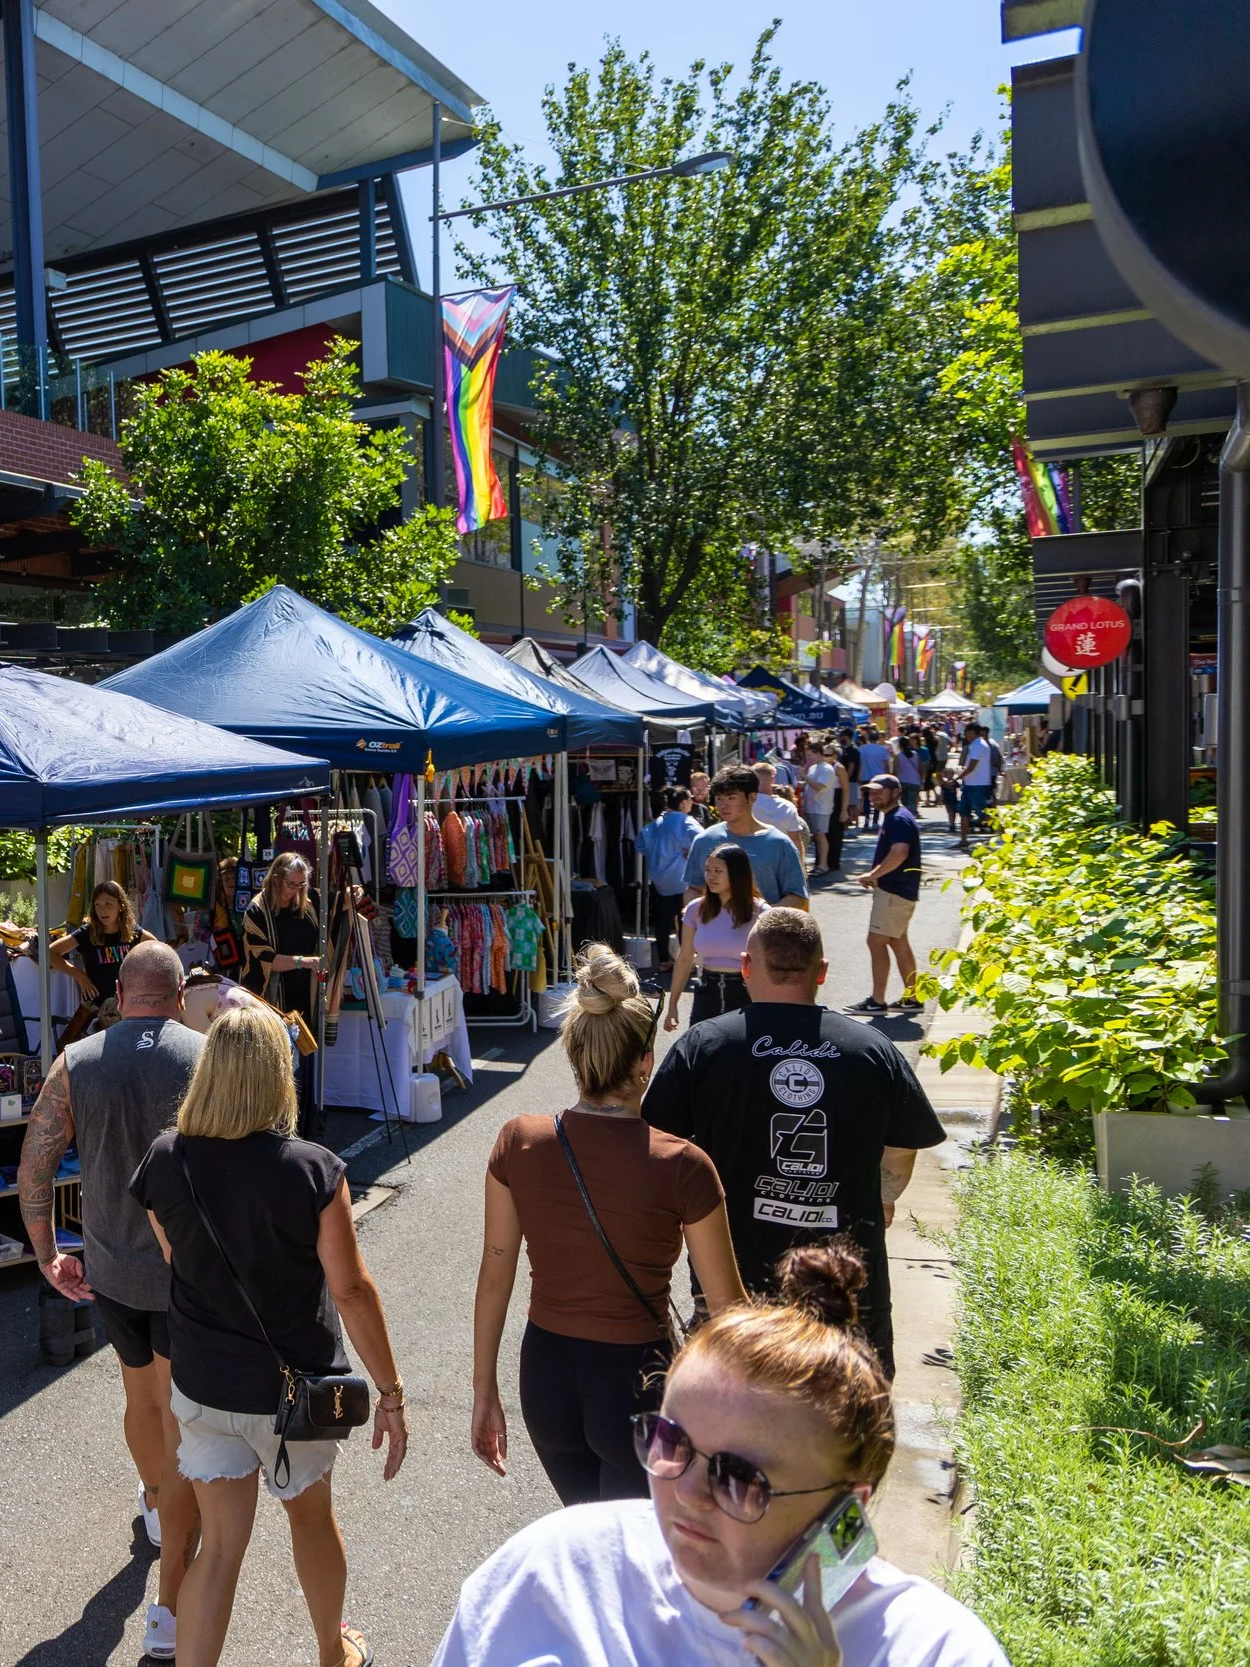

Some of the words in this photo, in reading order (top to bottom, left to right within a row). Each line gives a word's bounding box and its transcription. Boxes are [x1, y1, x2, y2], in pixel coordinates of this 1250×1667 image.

[1050, 622, 1088, 632] GRAND
[1090, 620, 1125, 629] LOTUS
[752, 1035, 841, 1058] Calidi
[778, 1064, 816, 1079] CALIDI
[778, 1086, 816, 1101] CLOTHING
